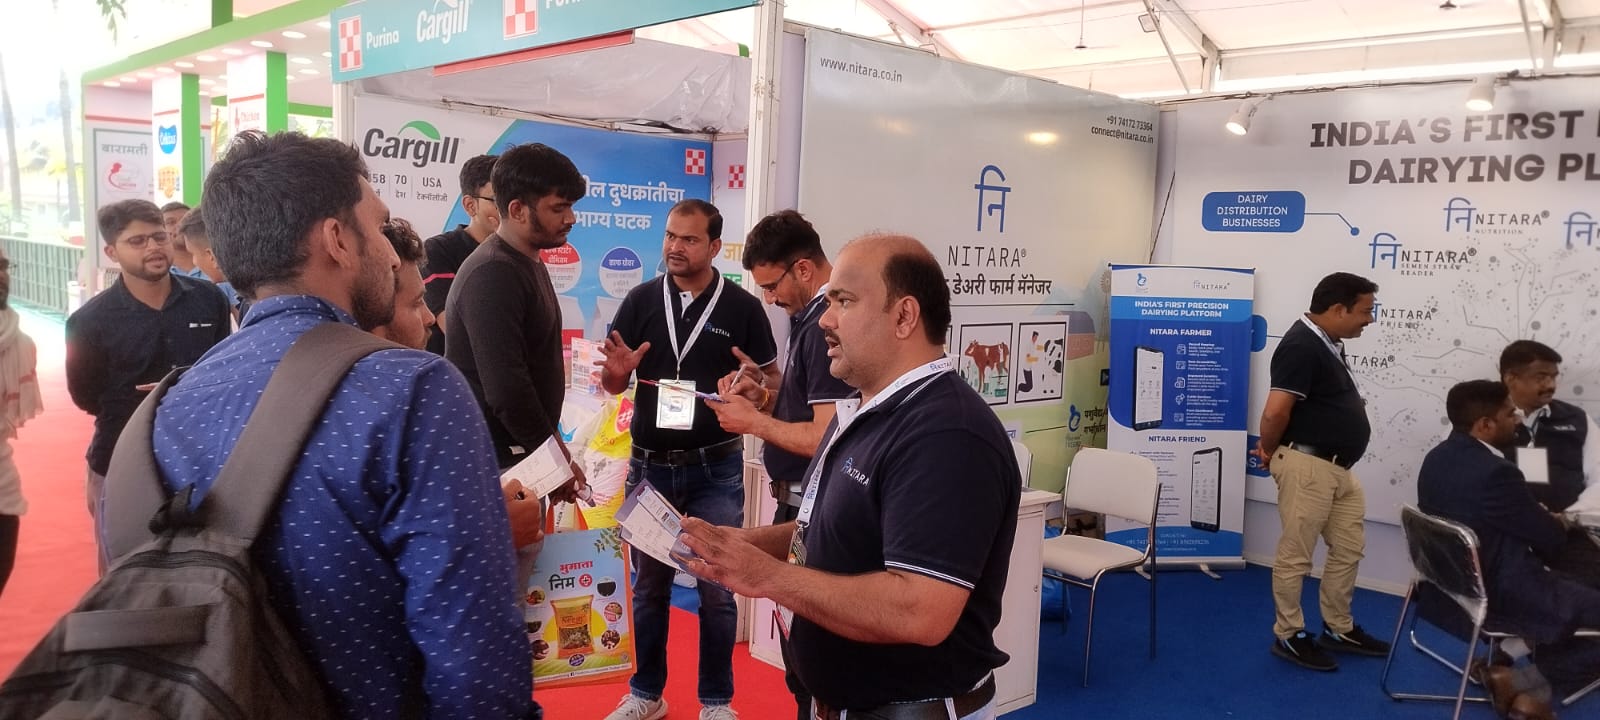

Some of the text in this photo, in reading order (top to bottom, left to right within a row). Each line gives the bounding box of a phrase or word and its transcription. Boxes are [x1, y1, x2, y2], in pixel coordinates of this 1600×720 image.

[416, 0, 470, 45] Cargill
[366, 28, 400, 49] Purina
[820, 57, 903, 83] www.nitara.co.in
[1090, 126, 1154, 144] connect@nitara.co.in
[1310, 117, 1451, 147] INDIA'S
[1463, 110, 1584, 142] FIRST
[363, 127, 460, 168] Cargill
[1348, 153, 1545, 185] DAIRYING
[394, 174, 408, 185] 70
[422, 176, 442, 188] USA
[1237, 194, 1269, 204] DAIRY
[1216, 206, 1289, 216] DISTRIBUTION
[613, 213, 651, 229] घटक
[1222, 218, 1281, 227] BUSINESSES
[952, 273, 1052, 295] डेअरी फार्म मॅनेजर
[1134, 301, 1229, 310] INDIA'S FIRST PRECISION
[1180, 310, 1222, 318] PLATFORM
[1150, 328, 1213, 337] NITARA FARMER
[1148, 435, 1177, 443] NITARA
[549, 574, 575, 591] निम
